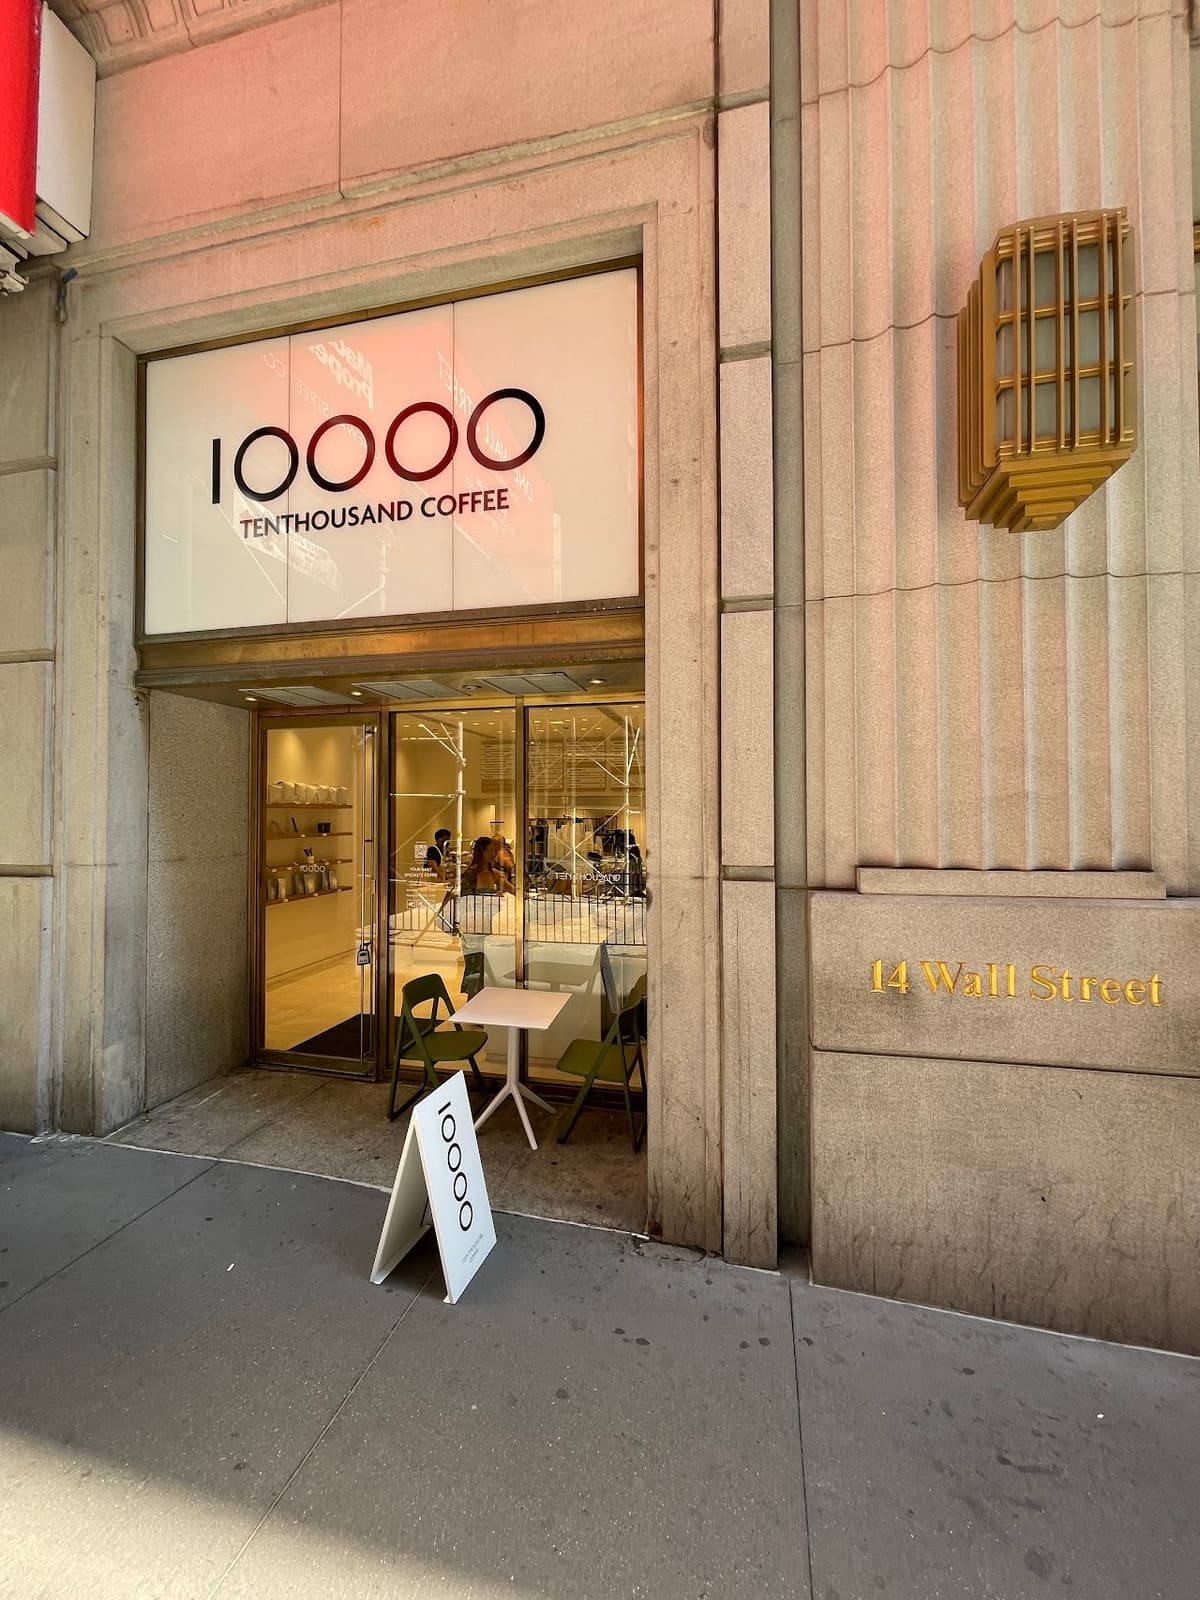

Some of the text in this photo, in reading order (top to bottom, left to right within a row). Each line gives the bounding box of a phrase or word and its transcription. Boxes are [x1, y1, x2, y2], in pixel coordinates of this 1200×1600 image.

[212, 388, 546, 505] 10000
[240, 488, 510, 539] TENTHOUSAND COFFEE
[870, 959, 1165, 1007] 14 Wall Street
[438, 1101, 473, 1231] 10000
